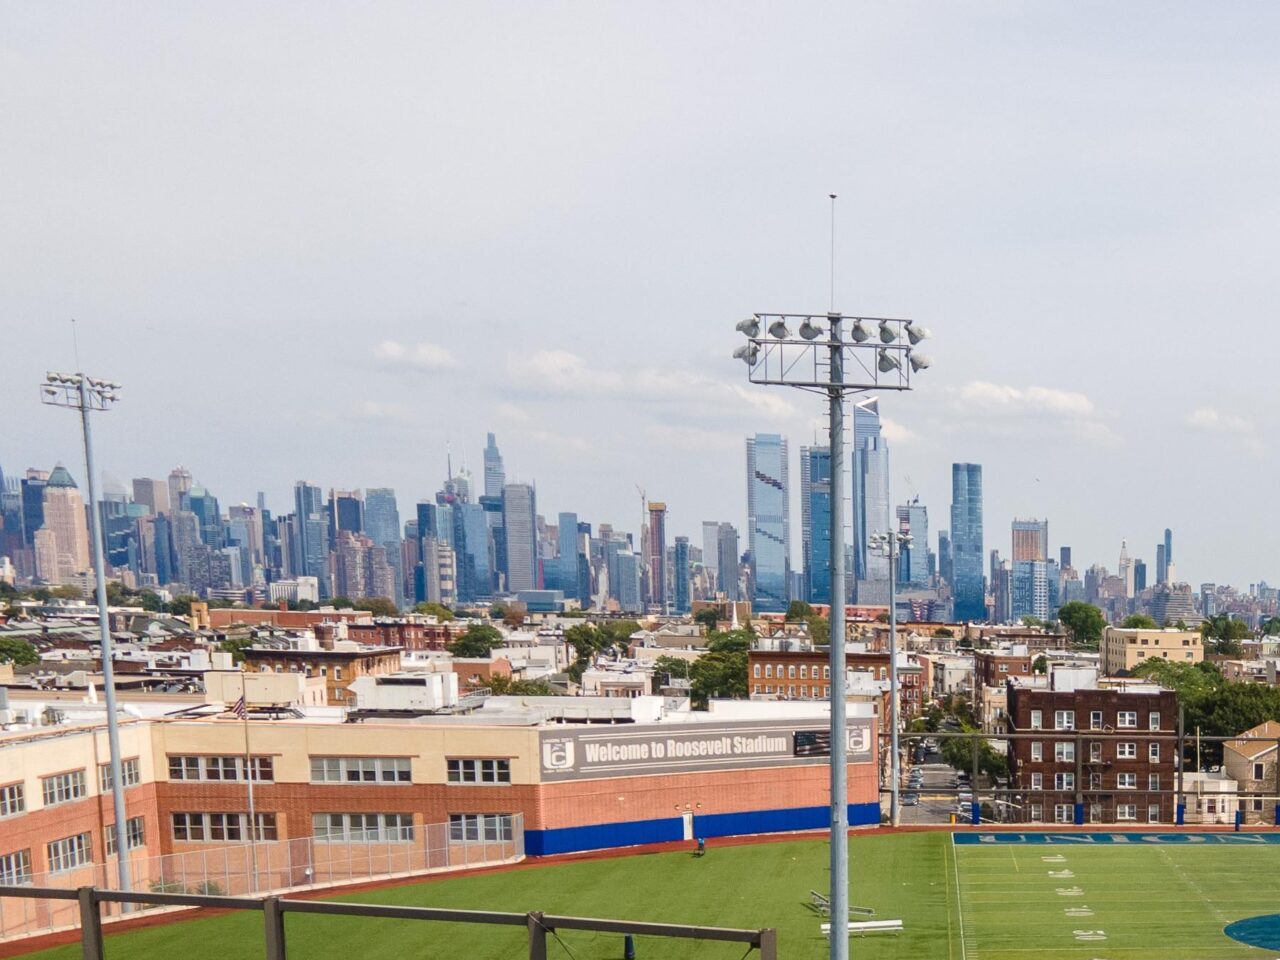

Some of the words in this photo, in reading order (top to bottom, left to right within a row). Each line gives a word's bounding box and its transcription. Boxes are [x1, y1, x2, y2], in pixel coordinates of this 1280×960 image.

[585, 742, 649, 762] Welcome
[651, 741, 665, 759] to
[667, 737, 732, 758] Roosevelt
[733, 735, 787, 754] Stadium
[979, 833, 1267, 844] UNION
